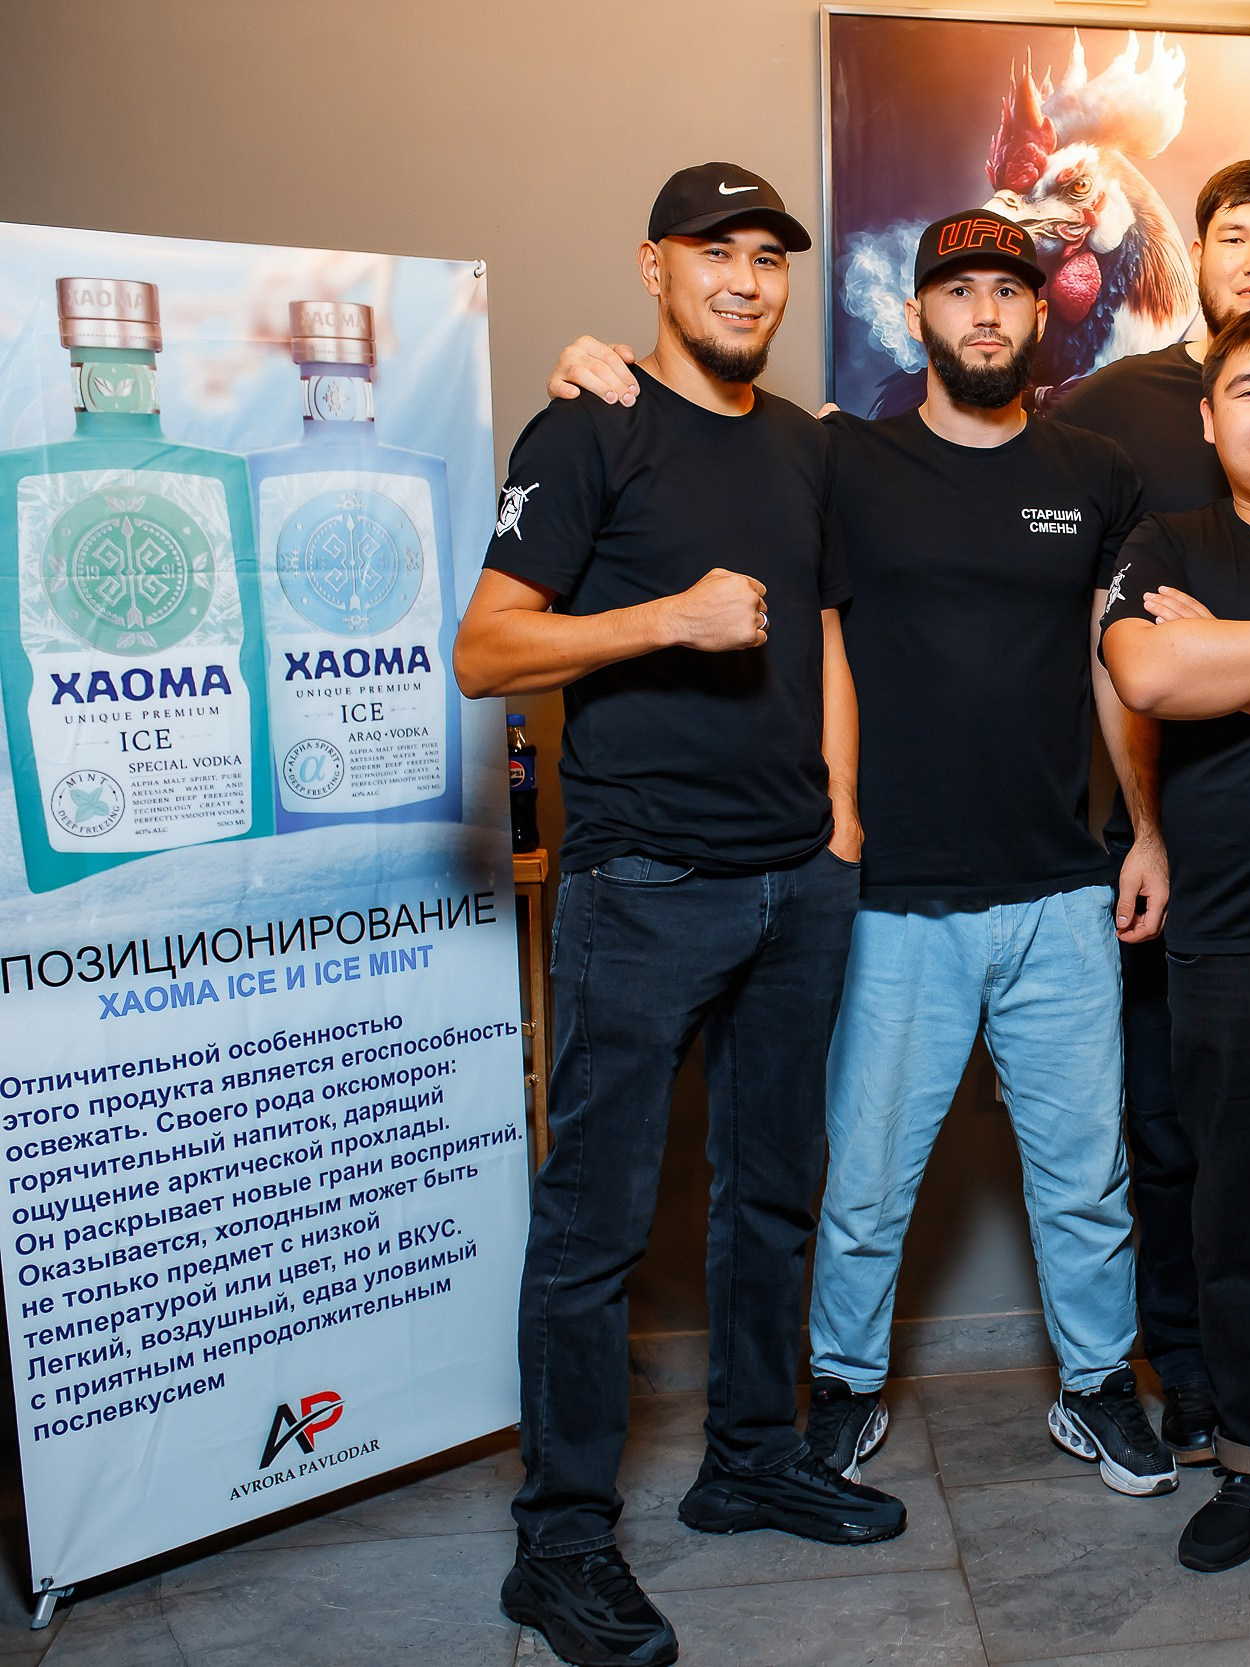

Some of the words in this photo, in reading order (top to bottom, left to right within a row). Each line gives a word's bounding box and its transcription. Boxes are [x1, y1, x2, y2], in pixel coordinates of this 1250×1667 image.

[938, 218, 1024, 256] UFC
[1021, 508, 1082, 522] СТАРШИЙ
[1029, 522, 1078, 534] СМЕНЫ
[65, 711, 133, 724] UNIQUE
[142, 707, 220, 720] PREMIUM
[296, 687, 352, 698] UNIQUE
[360, 683, 422, 694] PREMIUM
[341, 702, 385, 724] ICE
[120, 729, 173, 752] ICE
[288, 742, 312, 767] ALPHA
[315, 742, 340, 762] SPIRIT
[348, 730, 382, 743] ARAQ
[390, 727, 429, 739] VODKA
[66, 773, 108, 788] MINT
[129, 759, 188, 774] SPECIAL
[192, 755, 242, 768] VODKA
[131, 780, 159, 788] ALPHA
[163, 777, 186, 785] MALT
[58, 810, 78, 830] DEEP
[79, 805, 120, 834] FREEZING
[217, 808, 245, 816] VODKA
[0, 892, 496, 994] ПОЗИЦИОНИРОВАНИЕ
[228, 970, 276, 999] ICE
[286, 965, 305, 990] И
[315, 957, 360, 985] ICE
[370, 945, 433, 976] MINT
[0, 1043, 219, 1098] Отличительной
[229, 1015, 402, 1059] особенностью
[3, 1104, 79, 1131] этого
[89, 1080, 213, 1117] продукта
[222, 1056, 333, 1091] является
[342, 1022, 517, 1067] егоспособность
[6, 1125, 147, 1162] освежать.
[156, 1103, 247, 1132] Своего
[256, 1089, 314, 1118] рода
[322, 1060, 456, 1099] оксюморон:
[10, 1131, 224, 1194] горячительный
[234, 1114, 336, 1148] напиток,
[344, 1085, 443, 1128] дарящий
[12, 1181, 159, 1224] ощущение
[168, 1140, 322, 1194] арктической
[331, 1117, 449, 1157] прохлады.
[16, 1234, 54, 1255] Он
[64, 1196, 224, 1250] раскрывает
[232, 1177, 311, 1207] новые
[320, 1159, 382, 1189] грани
[391, 1123, 522, 1169] восприятий.
[19, 1232, 206, 1286] Оказывается,
[215, 1198, 340, 1241] холодным
[350, 1178, 417, 1207] может
[424, 1165, 478, 1188] быть
[22, 1298, 54, 1318] не
[62, 1273, 158, 1307] только
[168, 1243, 273, 1284] предмет
[281, 1238, 293, 1253] с
[301, 1210, 379, 1248] низкой
[24, 1282, 216, 1348] температурой
[226, 1273, 271, 1297] или
[279, 1256, 335, 1284] цвет,
[344, 1247, 370, 1265] но
[378, 1240, 390, 1256] и
[398, 1219, 461, 1250] ВКУС.
[28, 1336, 131, 1380] Легкий,
[142, 1292, 294, 1350] воздушный,
[303, 1278, 356, 1305] едва
[363, 1239, 476, 1293] уловимый
[31, 1394, 46, 1410] с
[56, 1352, 194, 1405] приятным
[203, 1278, 450, 1362] непродолжительным
[34, 1373, 225, 1441] послевкусием
[259, 1391, 345, 1470] AP
[230, 1469, 296, 1500] AVRORA
[299, 1440, 380, 1476] PAVLODAR
